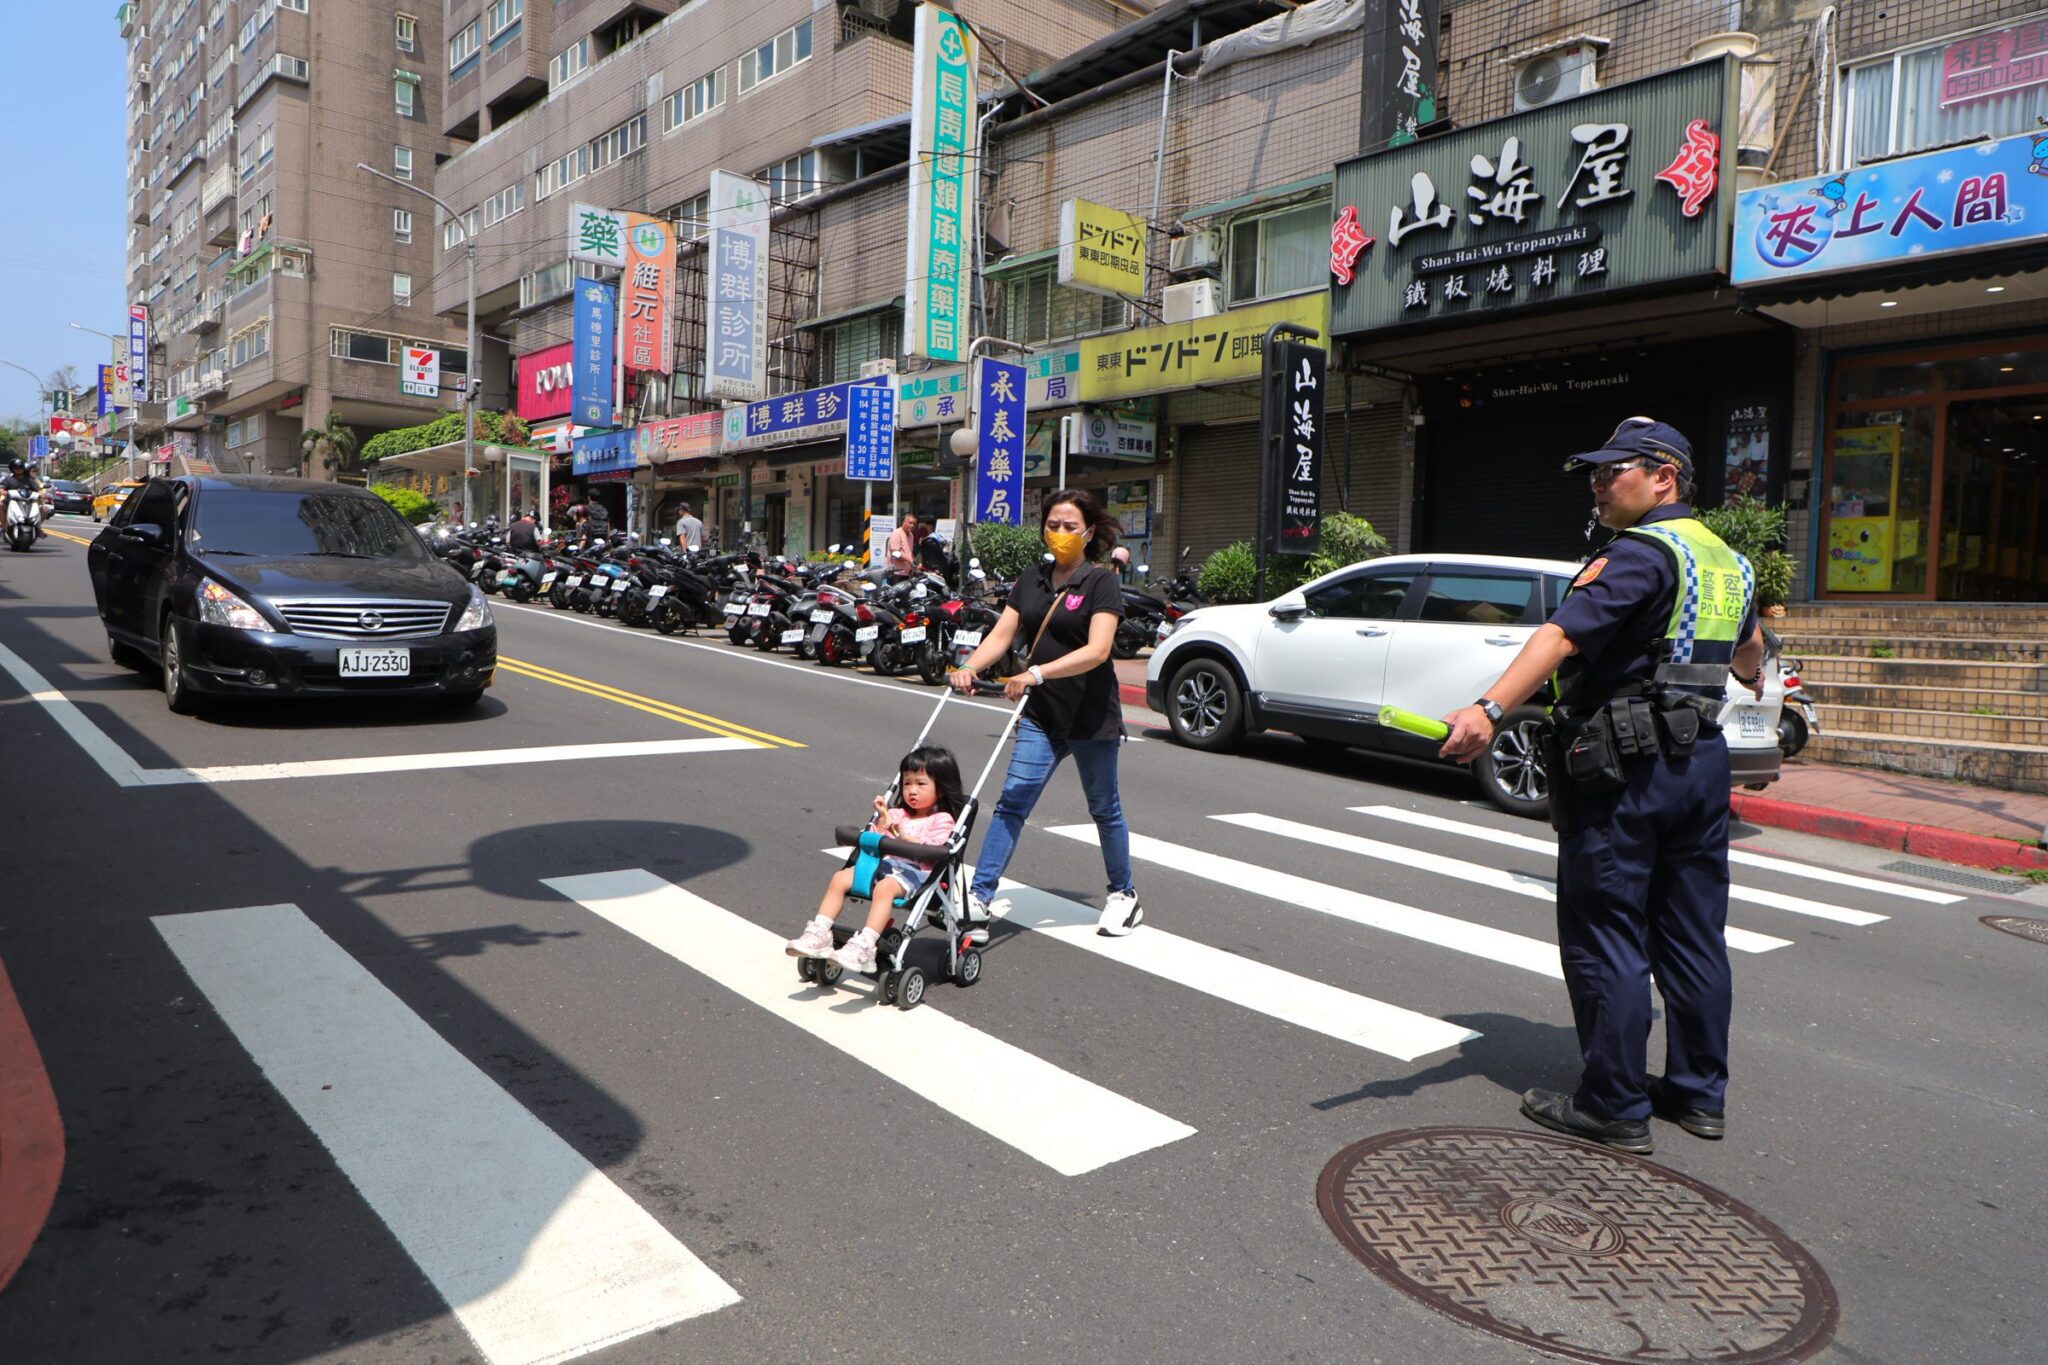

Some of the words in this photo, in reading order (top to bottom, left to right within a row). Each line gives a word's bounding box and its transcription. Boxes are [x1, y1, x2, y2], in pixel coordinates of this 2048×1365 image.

[1388, 123, 1632, 247] 山海屋
[580, 212, 620, 258] 藥
[1766, 172, 2007, 258] 夾上人間
[1080, 221, 1139, 256] ドンドン
[1080, 246, 1139, 275] 東東即期良品
[1421, 244, 1503, 270] Shan-Hai-Wu
[1505, 227, 1588, 254] Teppanyaki
[1404, 247, 1607, 308] 鐵板燒料理
[719, 235, 753, 374] 博群診所
[1045, 376, 1067, 401] 局
[1566, 373, 1630, 390] Teppanyaki
[750, 382, 877, 433] 博群診
[1292, 357, 1317, 482] 山海屋
[985, 370, 1018, 521] 承泰藥局
[1702, 569, 1741, 604] 警察
[1701, 602, 1741, 619] POLICE
